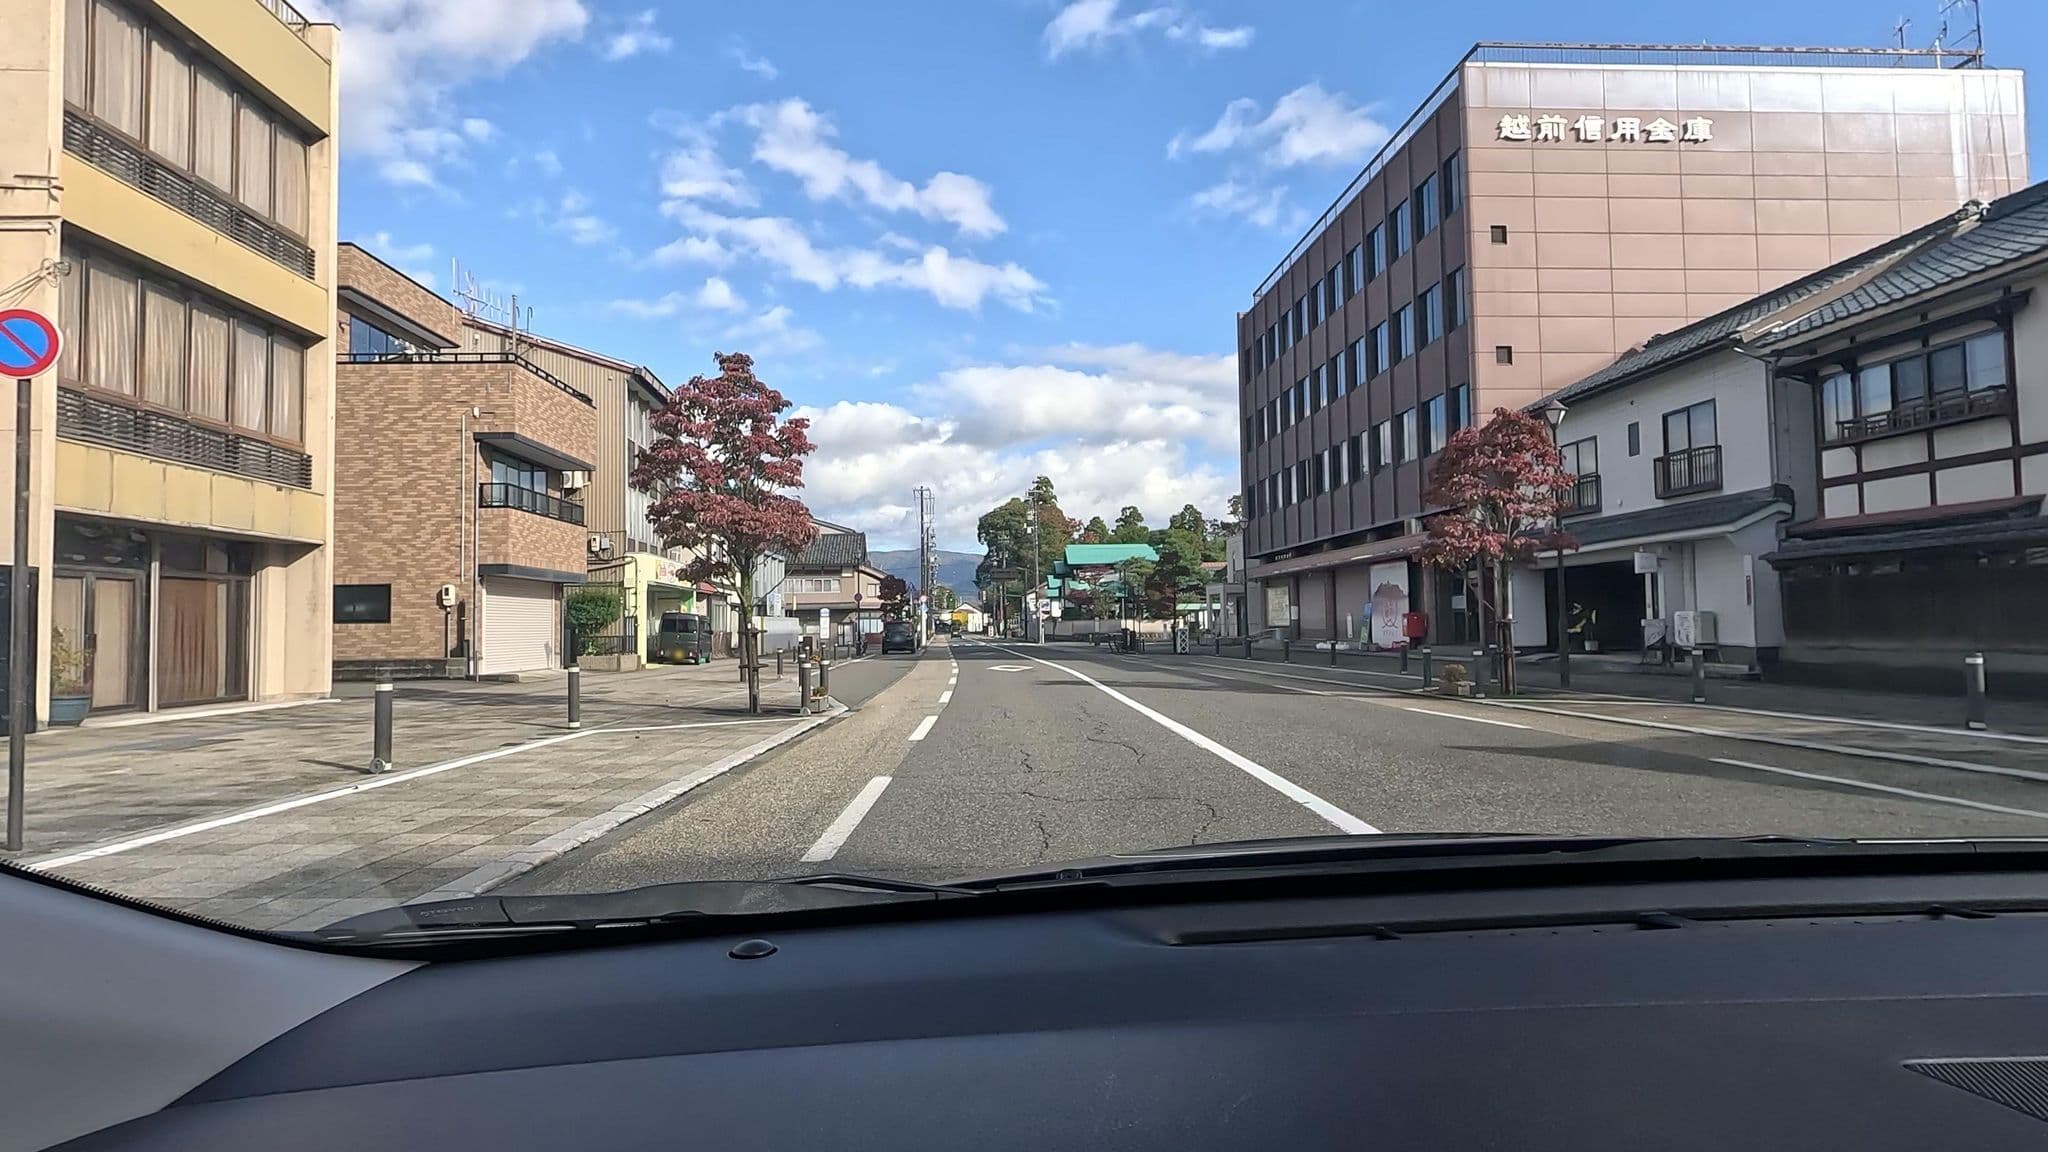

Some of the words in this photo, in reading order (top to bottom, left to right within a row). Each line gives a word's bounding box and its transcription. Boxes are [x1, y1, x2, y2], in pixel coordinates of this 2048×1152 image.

[1498, 113, 1714, 143] 越前信用金庫
